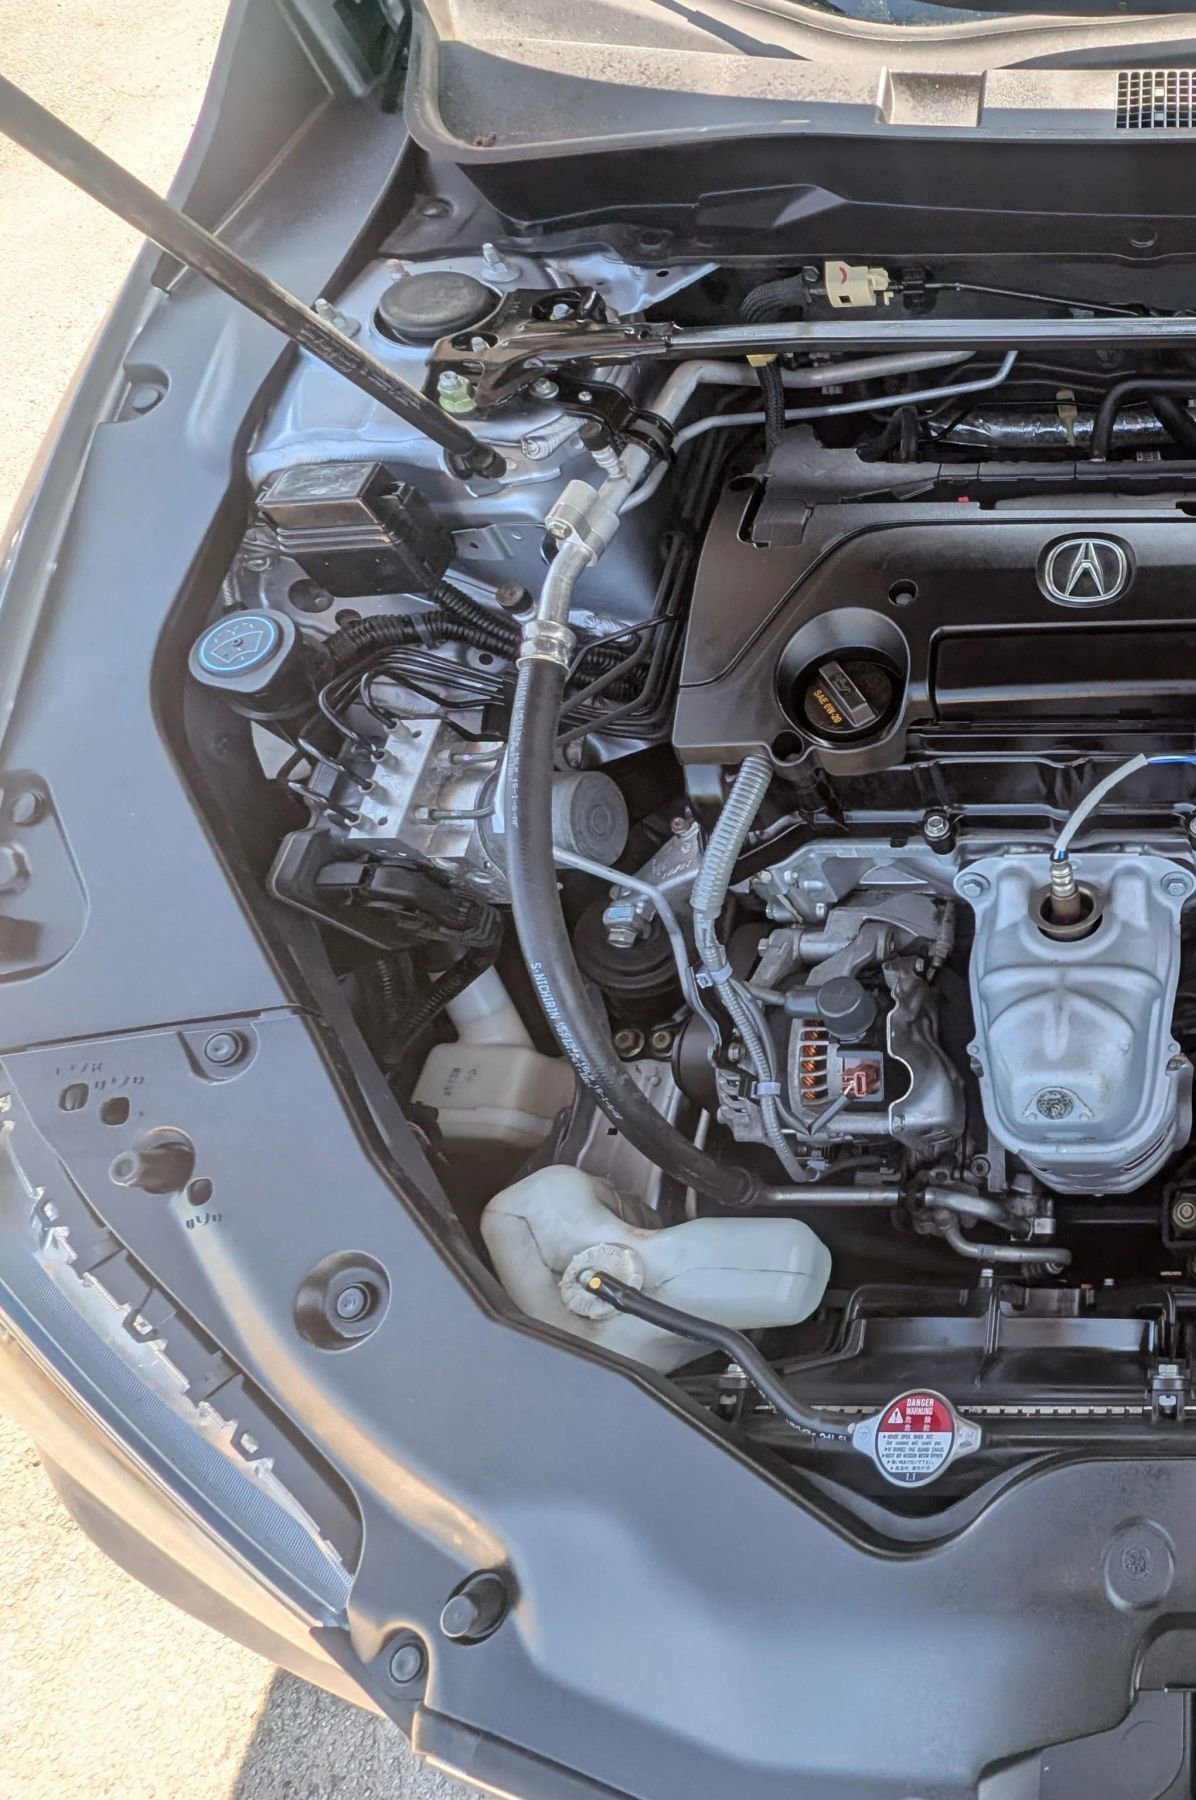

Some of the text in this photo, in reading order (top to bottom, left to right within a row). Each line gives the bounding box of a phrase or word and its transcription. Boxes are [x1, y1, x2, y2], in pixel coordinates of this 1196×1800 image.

[813, 690, 842, 722] SAE 0W-20
[907, 1399, 934, 1407] DANGER
[906, 1407, 933, 1415] WARNING
[906, 1473, 916, 1481] 1.1
